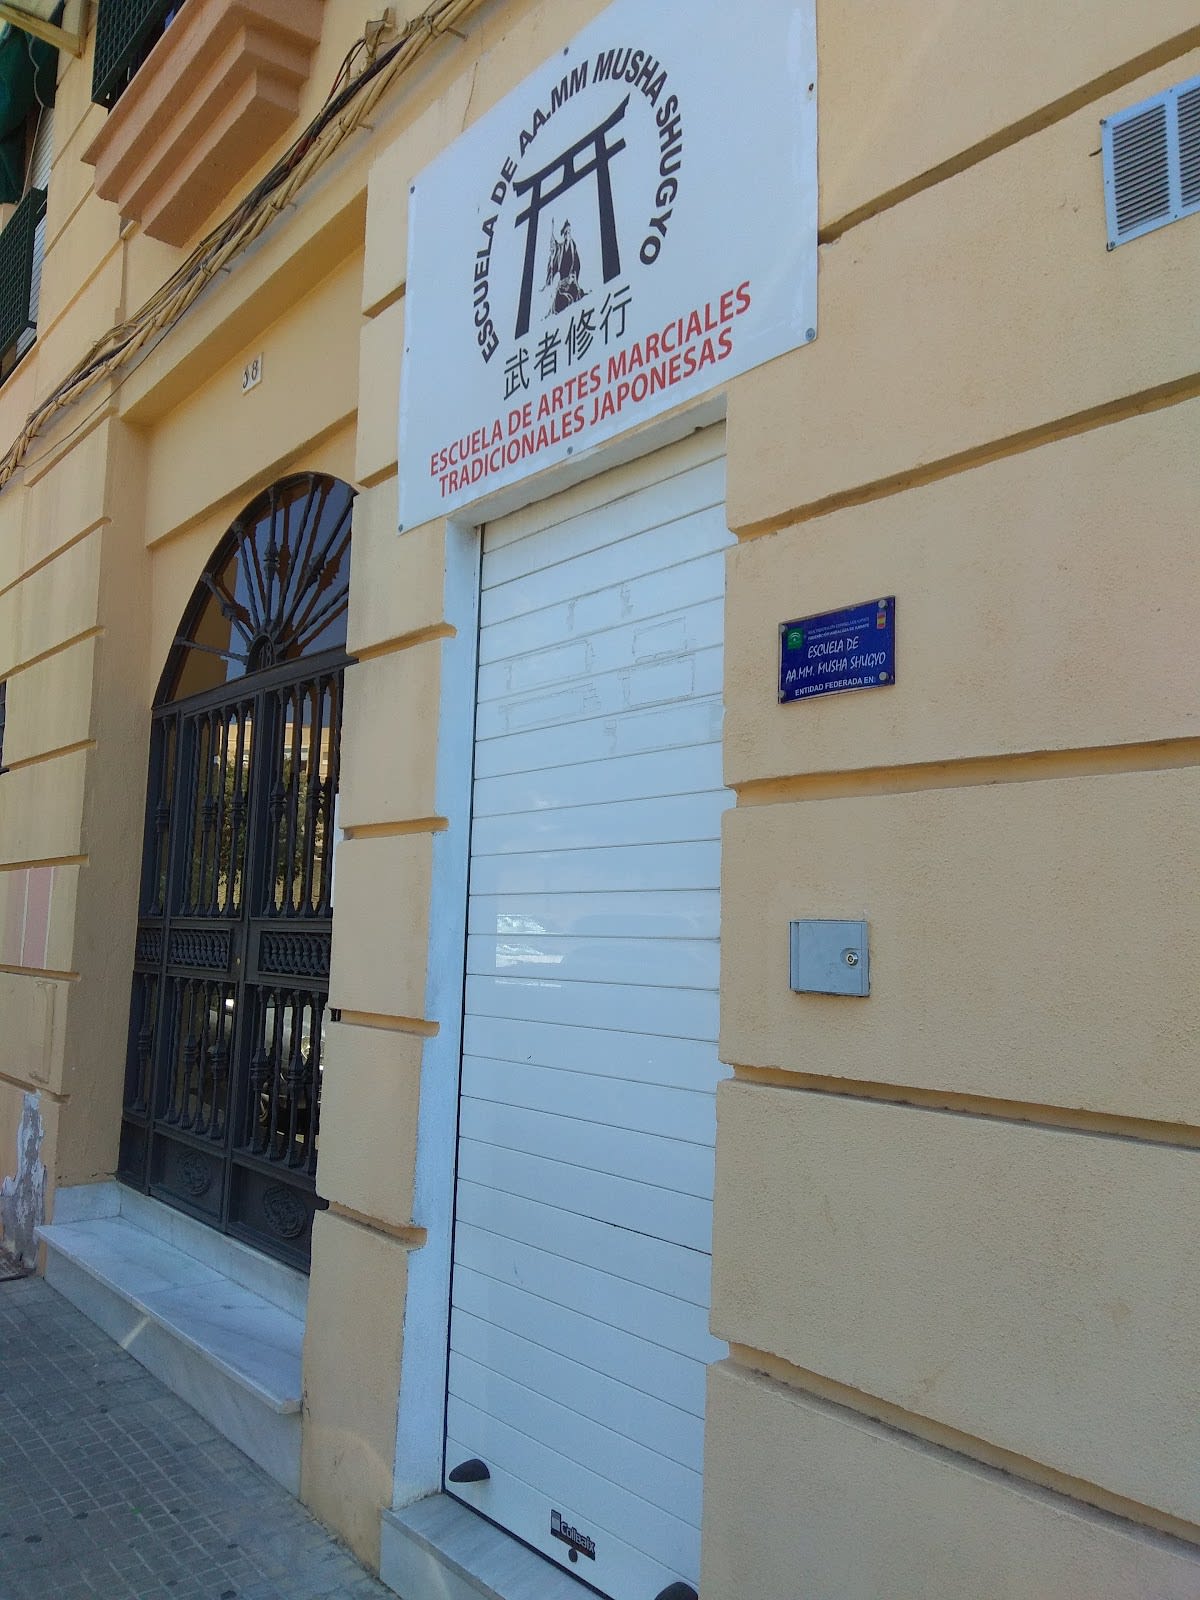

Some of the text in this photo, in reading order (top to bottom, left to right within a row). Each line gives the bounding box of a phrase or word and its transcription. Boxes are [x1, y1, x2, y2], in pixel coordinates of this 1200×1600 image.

[473, 47, 683, 364] ESCUELA DE AA.MM MUSHA SHUGYO
[430, 280, 752, 477] ESCUELA DE ARTES MARCIALES
[503, 285, 633, 401] 武者修行
[438, 326, 733, 498] TRADICIONALES JAPONESAS
[794, 683, 824, 697] ENTIDAD
[824, 677, 863, 690] FEDERADA
[807, 636, 860, 659] ESCUELA DE
[817, 657, 848, 675] MUSHA
[850, 651, 886, 670] SHUGYO
